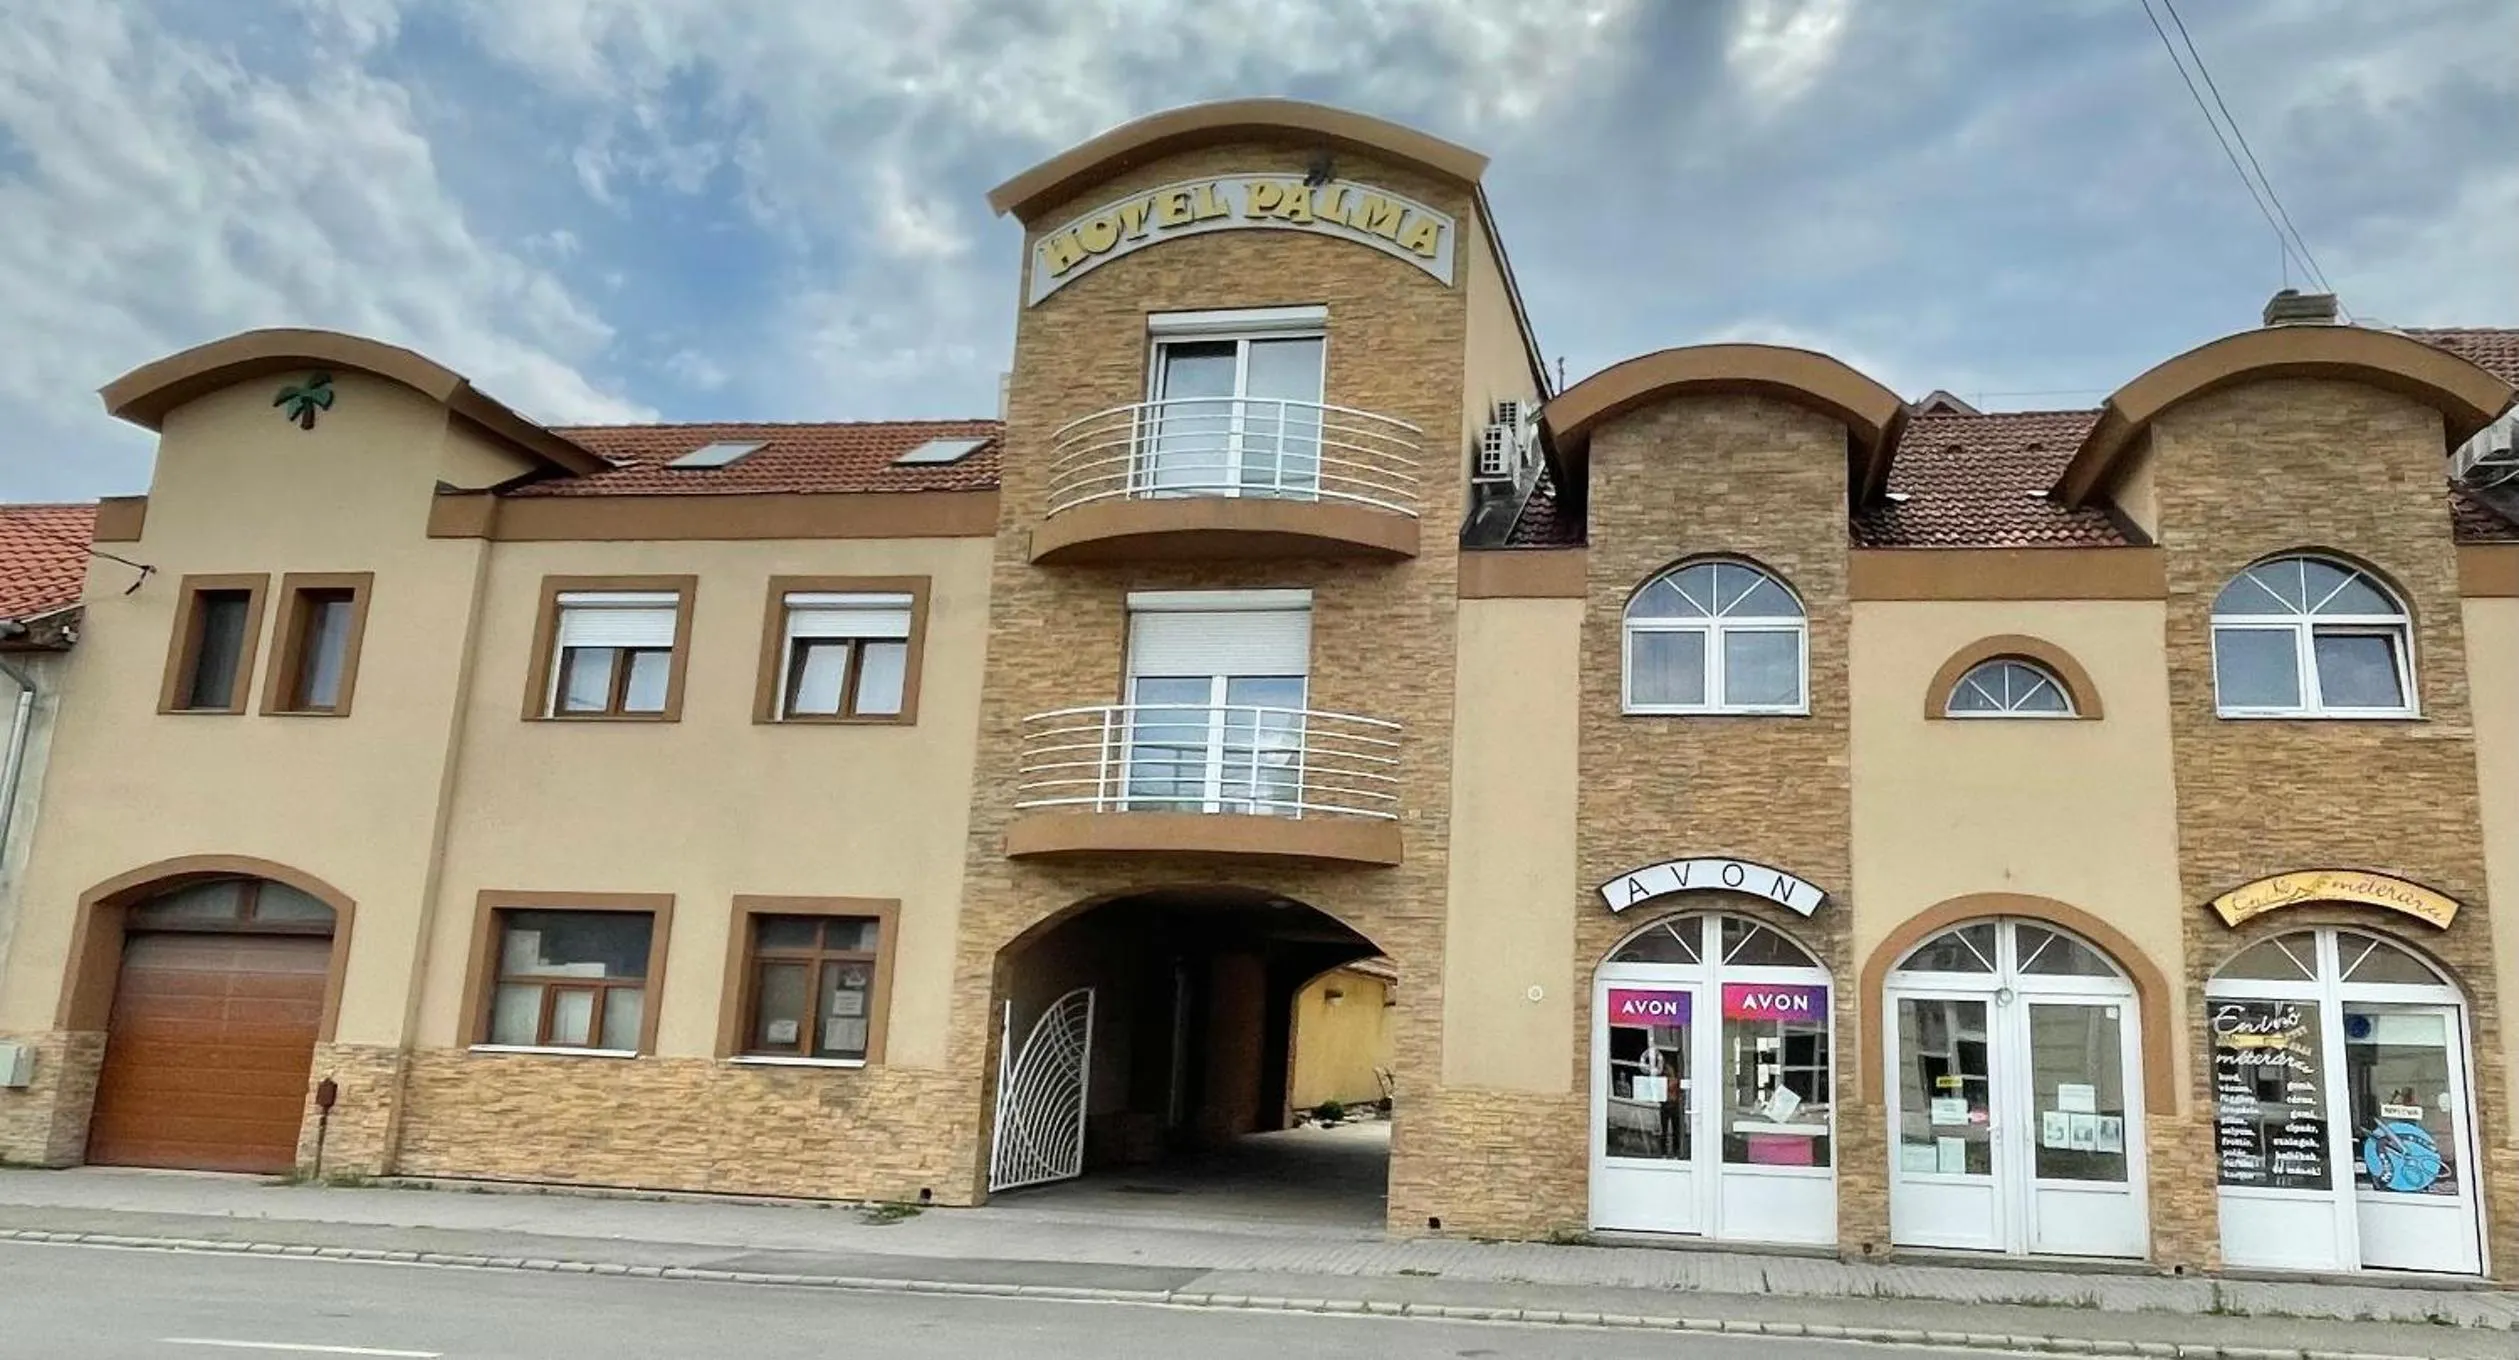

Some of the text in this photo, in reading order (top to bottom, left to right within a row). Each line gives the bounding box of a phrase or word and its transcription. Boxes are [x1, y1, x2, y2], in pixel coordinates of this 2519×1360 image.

[1039, 183, 1230, 278] HOTEL
[1627, 863, 1797, 904] AVON
[1622, 1000, 1677, 1016] AVON
[1743, 994, 1808, 1011] AVON
